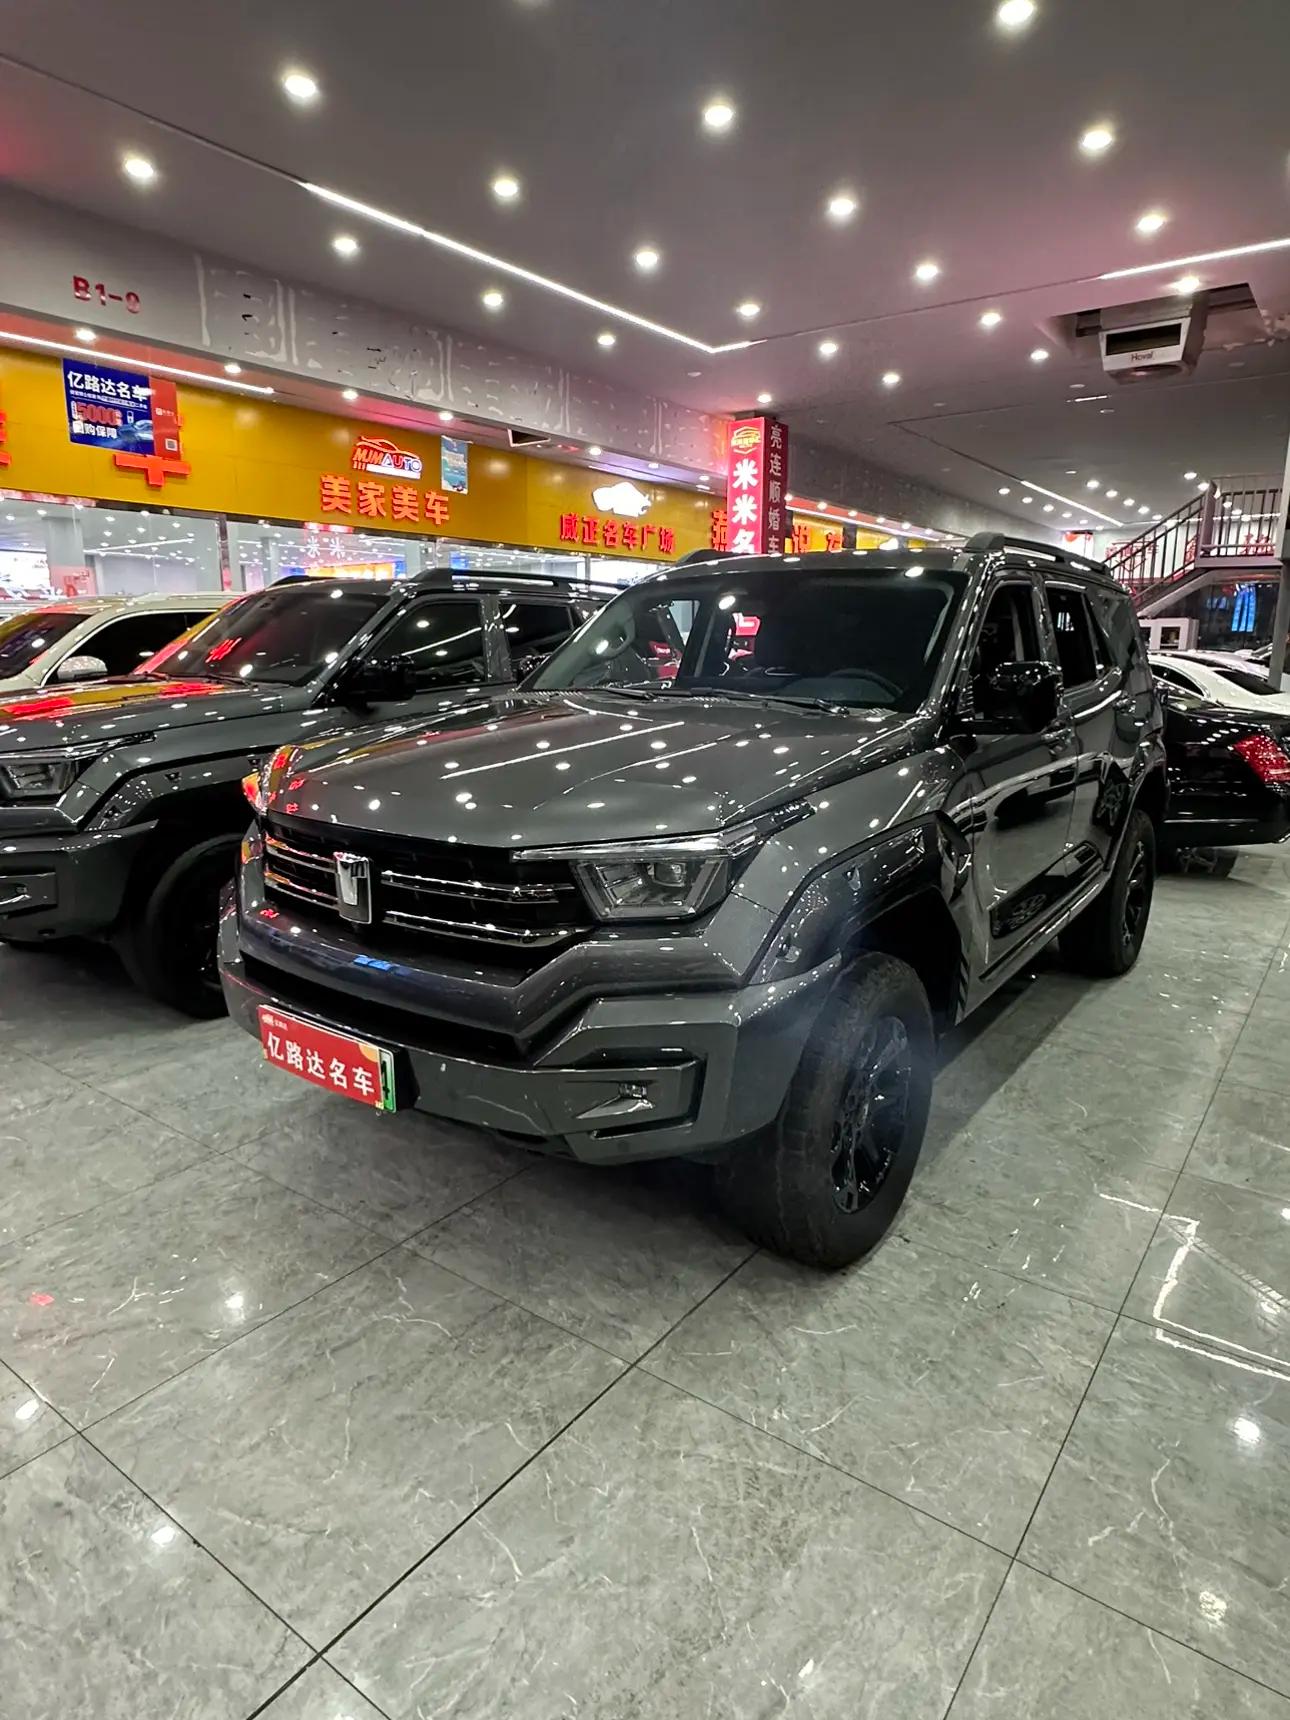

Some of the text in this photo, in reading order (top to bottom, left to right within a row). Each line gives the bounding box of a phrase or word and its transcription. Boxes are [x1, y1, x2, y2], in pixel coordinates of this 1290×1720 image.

[67, 371, 149, 402] 亿路达名车
[320, 474, 450, 525] 美家美车
[560, 512, 675, 553] 威正名车广场
[267, 1032, 375, 1096] 亿路达名车
